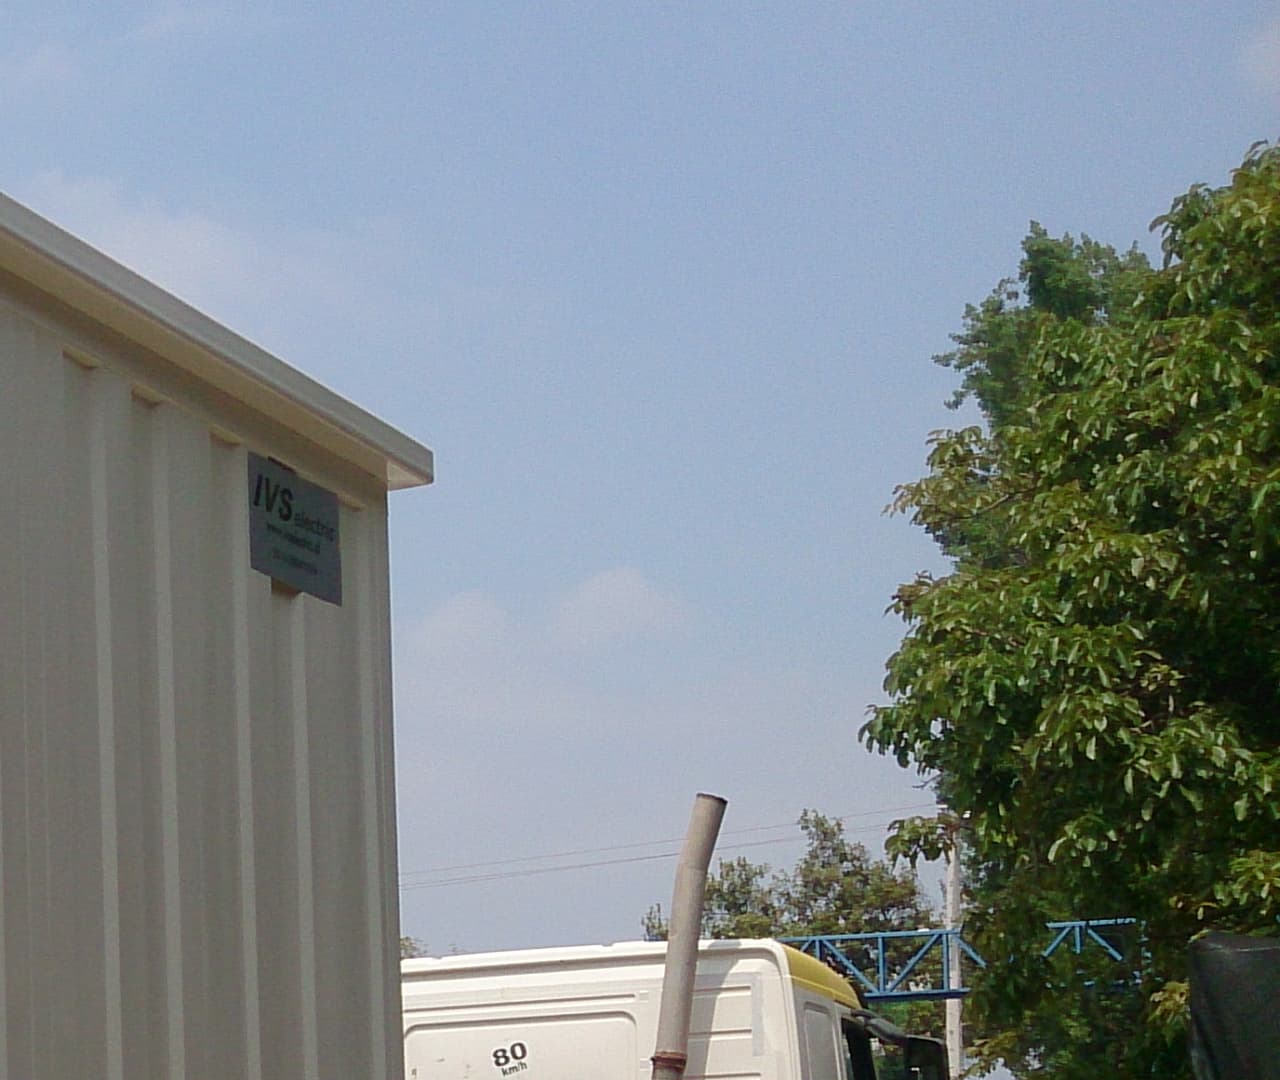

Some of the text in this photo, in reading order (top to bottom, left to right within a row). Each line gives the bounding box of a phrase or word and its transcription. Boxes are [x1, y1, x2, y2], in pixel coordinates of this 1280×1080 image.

[253, 473, 294, 521] IVS
[492, 1042, 527, 1067] 80
[501, 1060, 528, 1077] km/h
